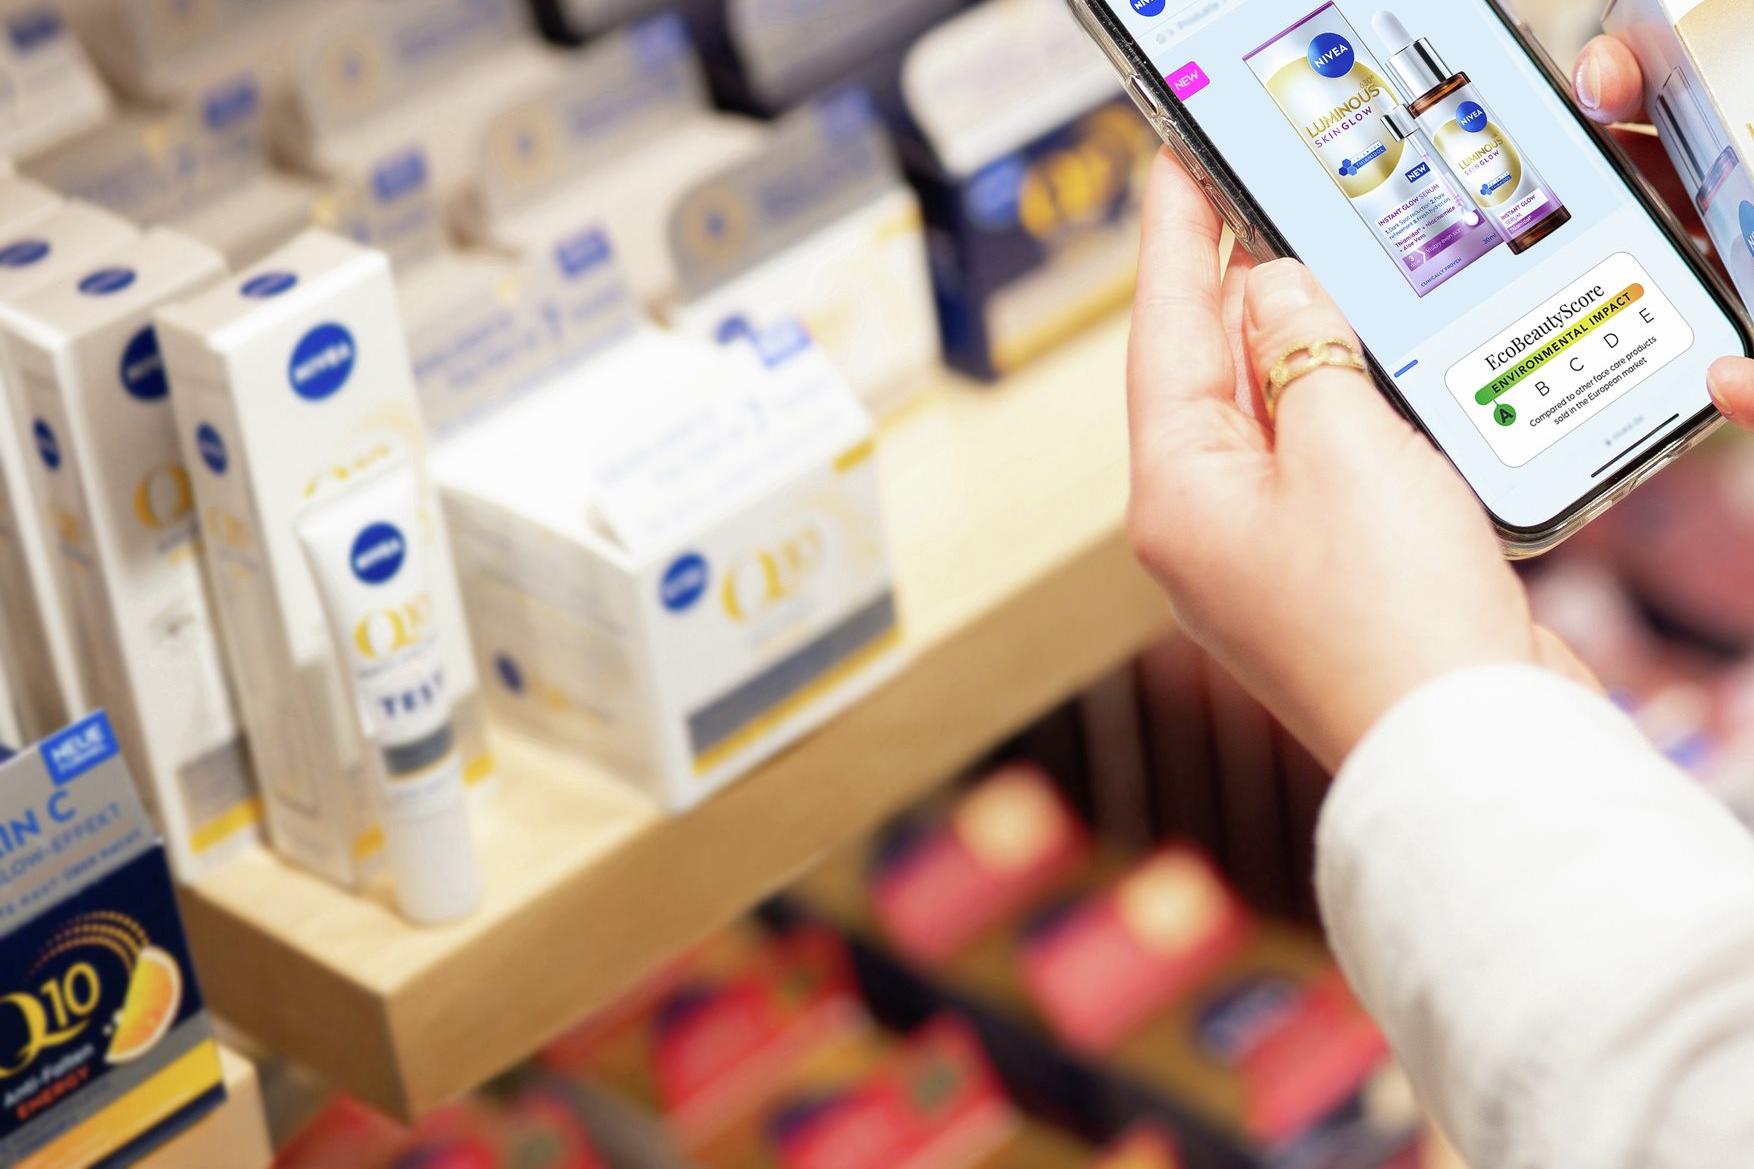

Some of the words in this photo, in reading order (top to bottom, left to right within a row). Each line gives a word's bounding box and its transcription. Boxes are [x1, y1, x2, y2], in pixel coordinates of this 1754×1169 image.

[1314, 44, 1349, 68] NIVEA
[1174, 70, 1199, 91] NEW
[1305, 85, 1380, 138] LUMINOUS
[1460, 109, 1483, 126] NIVEA
[1407, 164, 1426, 181] NEW
[1458, 138, 1504, 170] LUMINOUS
[1378, 209, 1402, 227] INSTANT
[1402, 196, 1420, 211] GLOW
[1419, 183, 1440, 200] SERUM
[1501, 204, 1521, 220] INSTANT
[1520, 194, 1537, 206] GLOW
[1402, 241, 1415, 251] Aloe
[1484, 285, 1605, 371] EcoBeautyScore
[1491, 324, 1588, 394] ENVIRONMENTAL
[1589, 292, 1631, 326] IMPACT
[294, 341, 350, 382] NIVEA
[1499, 408, 1514, 424] A
[1535, 380, 1550, 397] B
[1569, 357, 1584, 372] C
[1603, 333, 1619, 348] D
[1639, 307, 1654, 323] E
[1529, 398, 1568, 427] Compared
[1566, 392, 1575, 402] to
[1575, 380, 1594, 396] other
[1592, 369, 1611, 383] face
[1610, 357, 1626, 371] care
[1625, 336, 1657, 361] products
[1554, 410, 1569, 425] sold
[1568, 405, 1578, 415] in
[1575, 397, 1589, 409] the
[1587, 374, 1623, 401] European
[1621, 356, 1648, 378] market
[355, 538, 400, 571] NIVEA
[51, 723, 102, 767] NEUE
[47, 789, 77, 823] C
[16, 1064, 89, 1119] ENERGY
